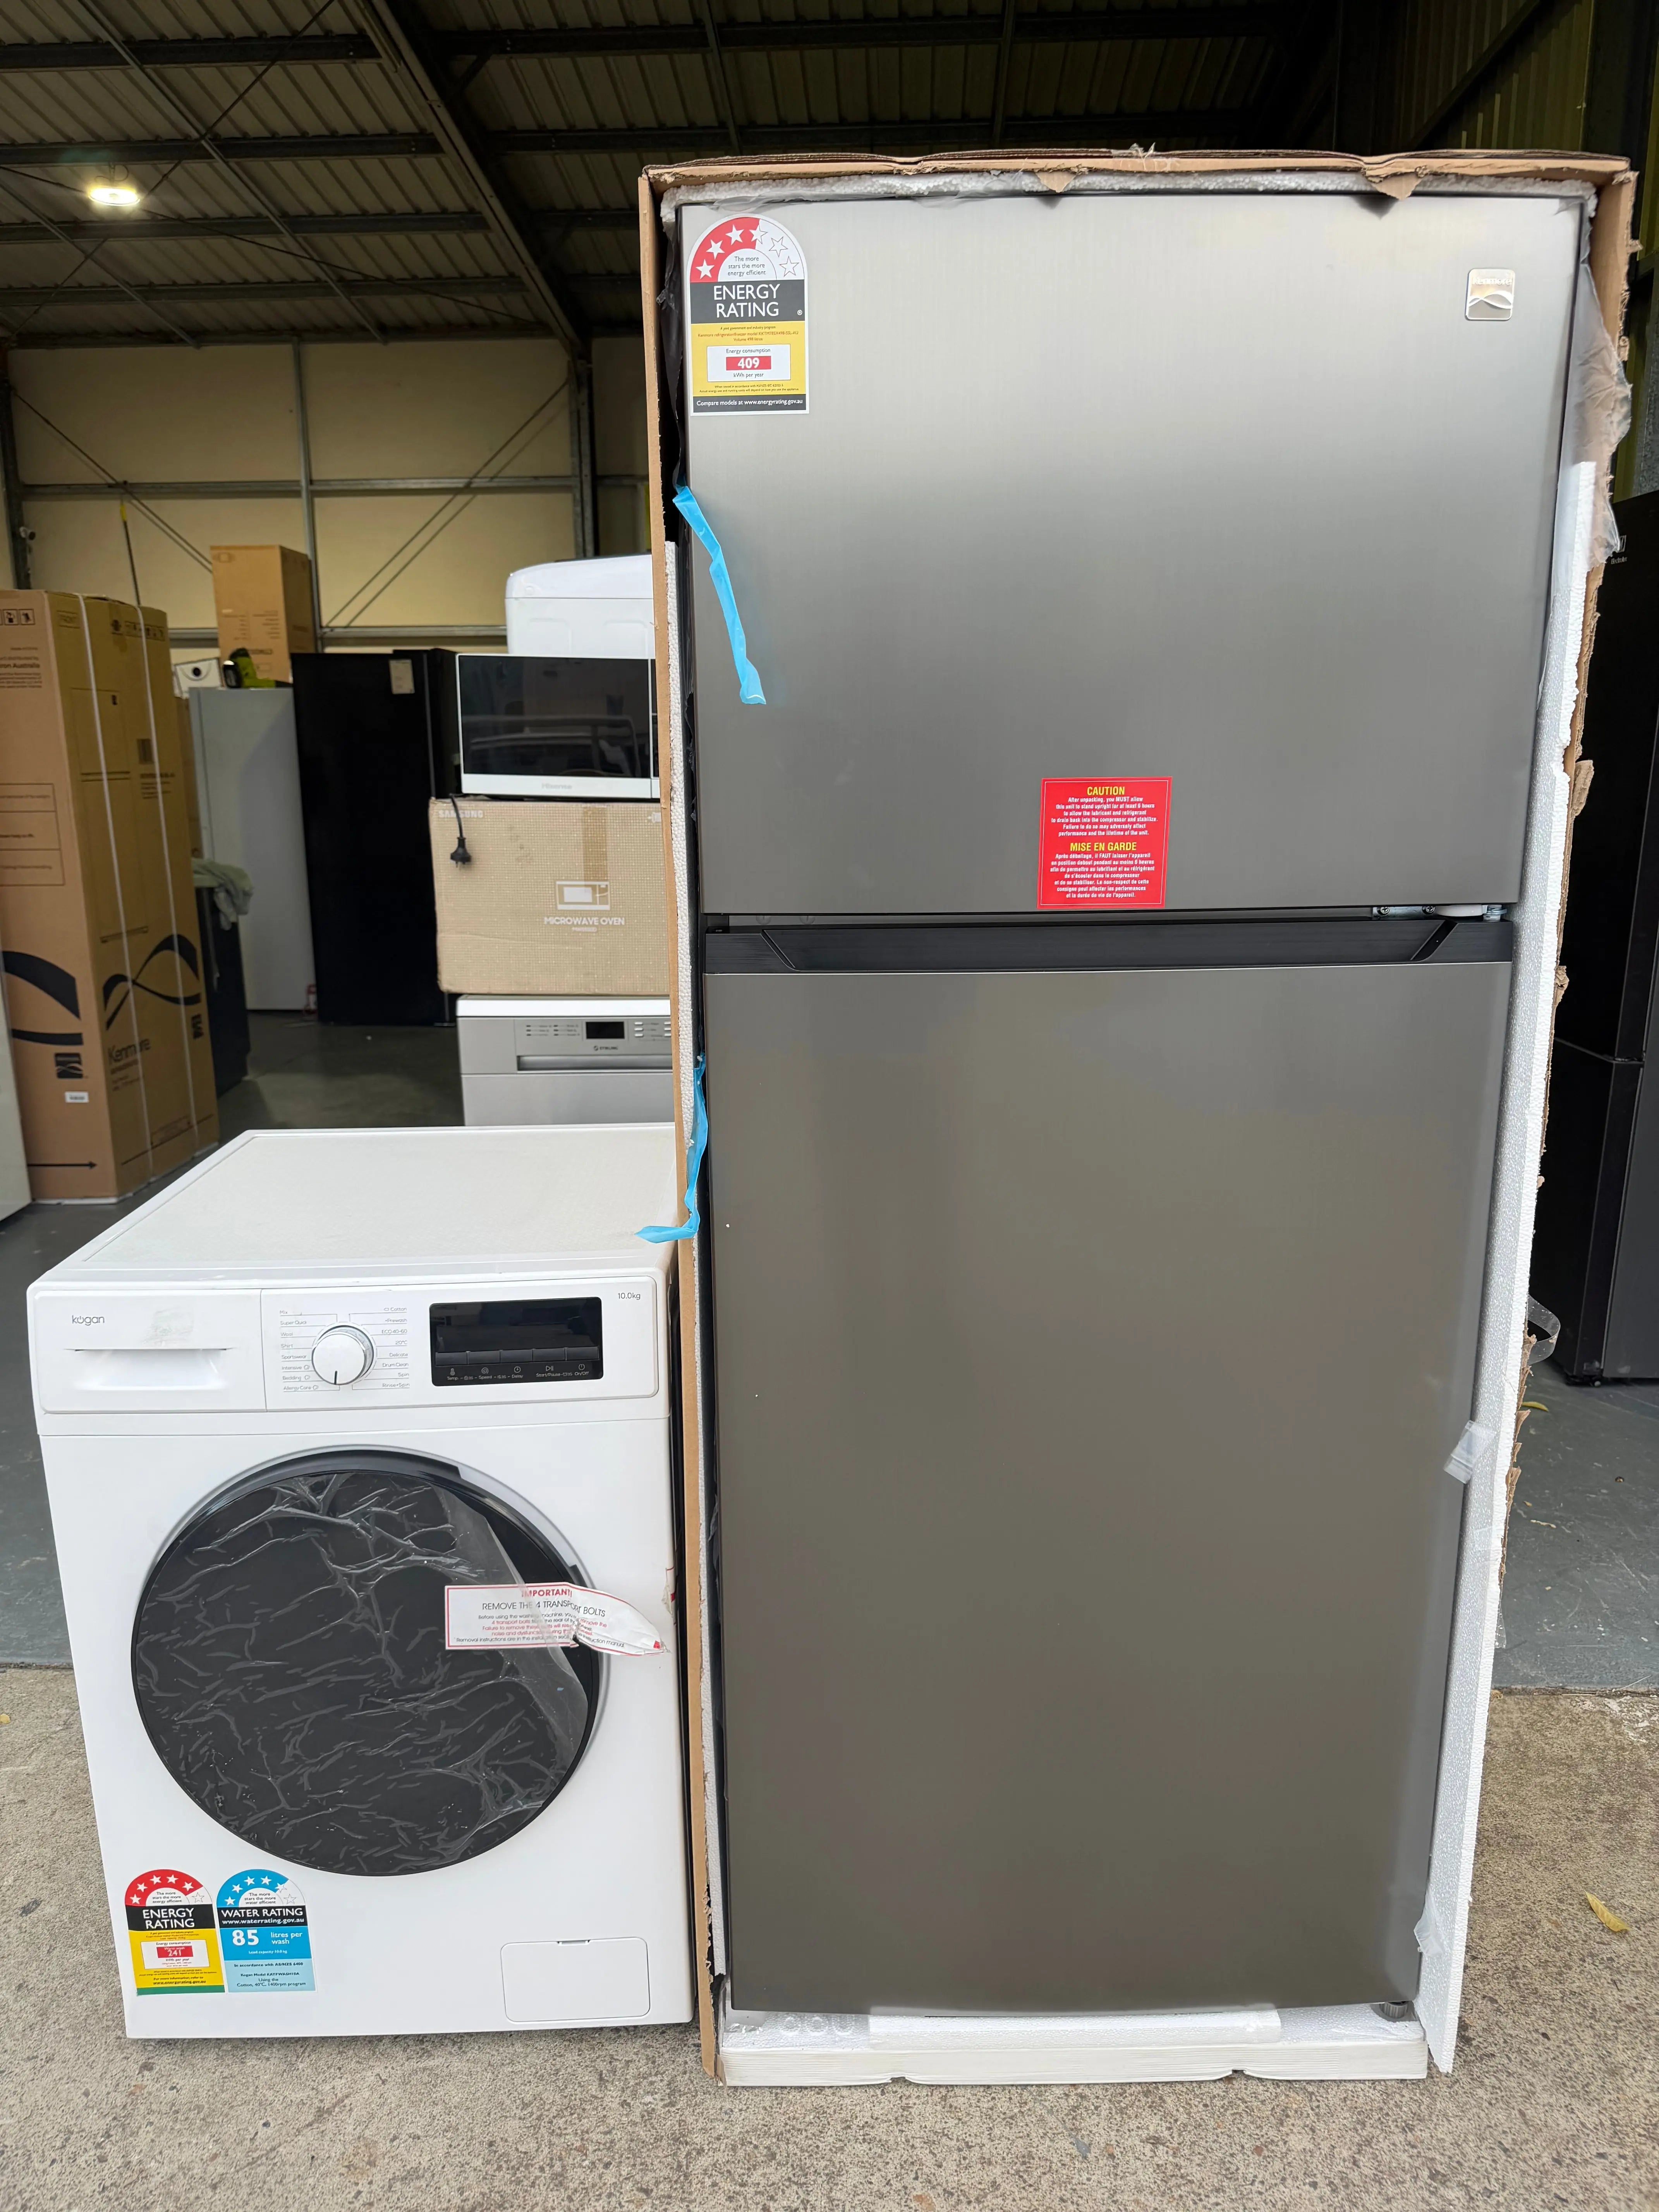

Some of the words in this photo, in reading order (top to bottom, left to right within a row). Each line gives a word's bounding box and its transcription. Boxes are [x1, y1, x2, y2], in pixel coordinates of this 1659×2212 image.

[714, 284, 780, 300] ENERGY
[716, 302, 779, 318] RATING
[738, 357, 759, 369] 409
[1087, 786, 1125, 795] CAUTION
[1070, 843, 1091, 851] MISE
[1094, 843, 1105, 851] EN
[1108, 842, 1137, 851] GARDE
[108, 1039, 150, 1063] Kenmre
[617, 1292, 641, 1300] 10.0kg
[72, 1315, 105, 1326] kogan
[543, 1600, 581, 1613] TRANSPORT
[583, 1607, 605, 1617] BOLTS
[143, 1908, 194, 1919] ENERGY
[221, 1909, 259, 1918] WATER
[262, 1908, 303, 1917] RATING
[145, 1918, 195, 1929] RATING
[232, 1929, 259, 1946] 85
